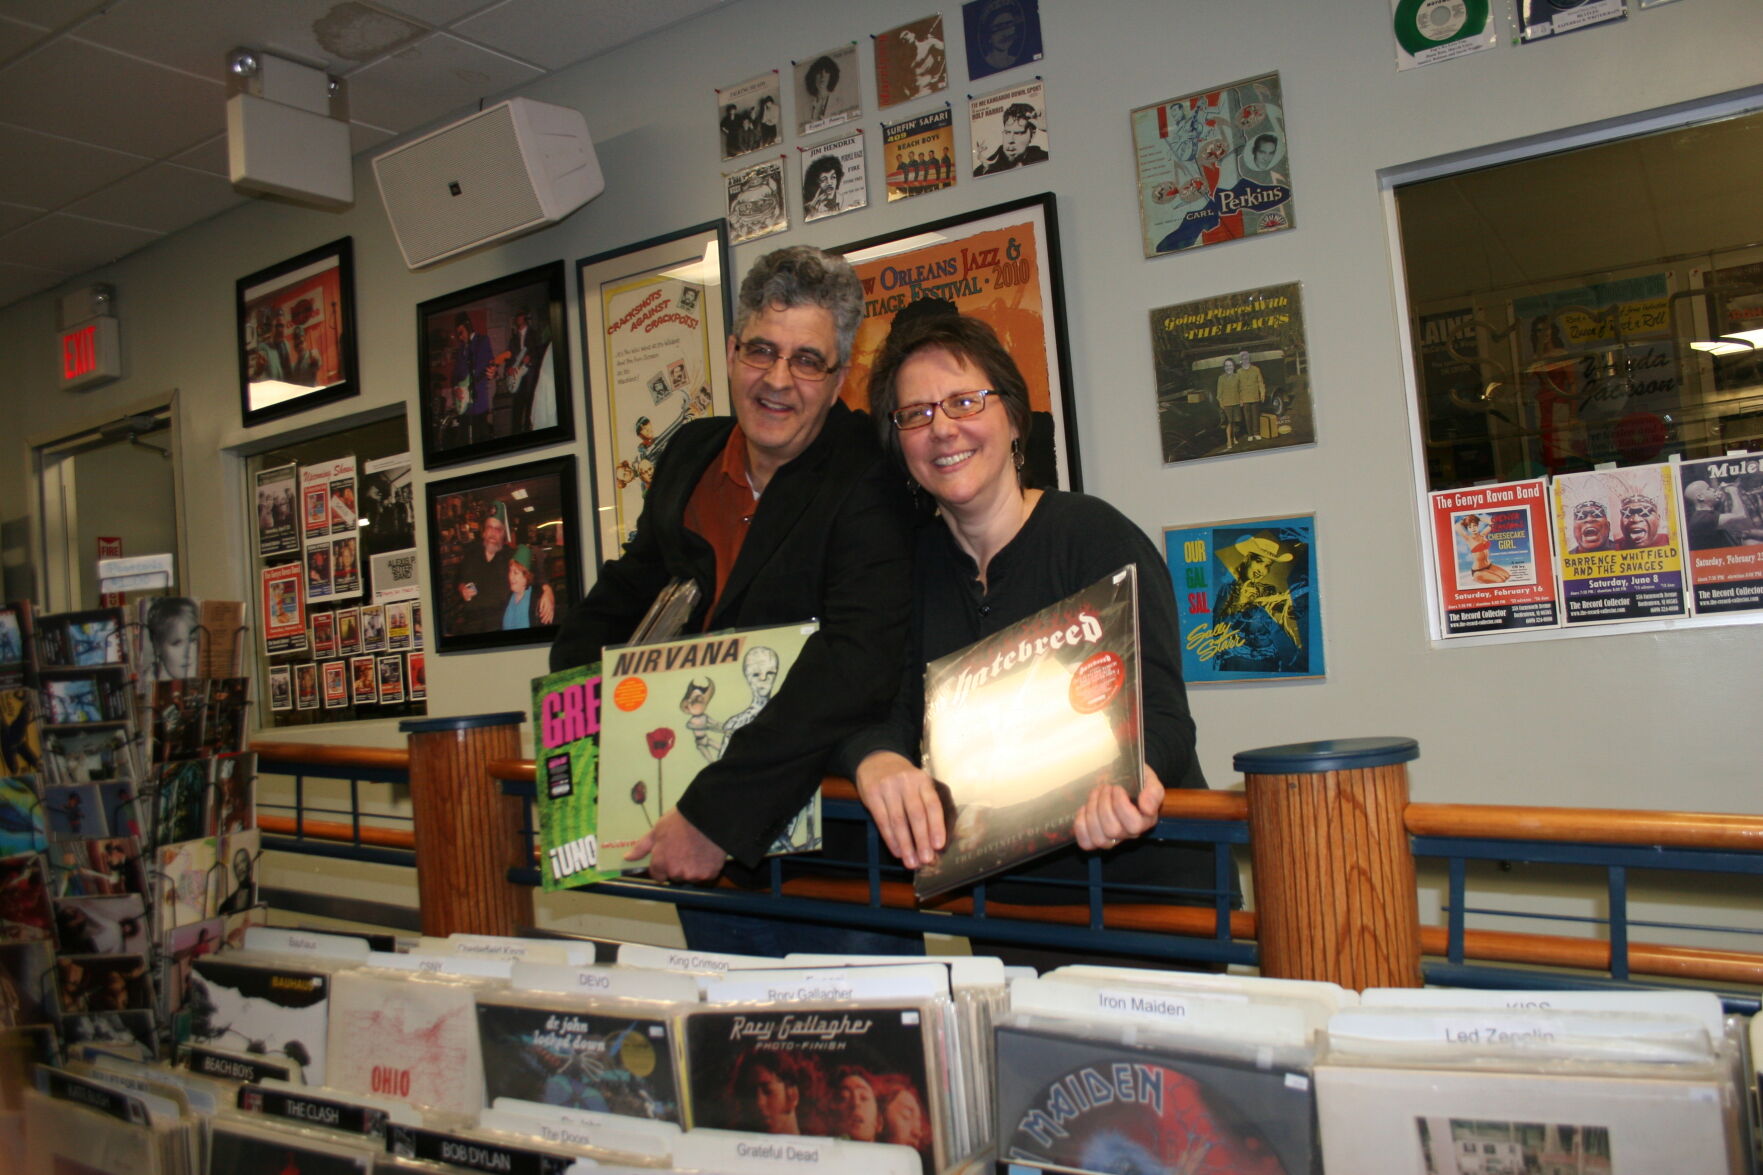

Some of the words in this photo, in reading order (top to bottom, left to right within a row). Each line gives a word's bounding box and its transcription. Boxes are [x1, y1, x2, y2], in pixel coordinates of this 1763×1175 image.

[886, 120, 917, 137] SURFIN'
[920, 112, 949, 127] SAFARI
[823, 138, 856, 152] HENDRIX
[897, 140, 920, 151] BEACH
[922, 134, 940, 145] BOYS
[1218, 186, 1283, 212] Perkins
[1186, 210, 1214, 221] CARL
[880, 256, 958, 291] ORLEANS
[960, 247, 1001, 281] JAZZ
[1006, 237, 1022, 261] &
[863, 293, 907, 319] ITAGE
[910, 276, 983, 300] FESTIVAL
[992, 258, 1030, 290] 2010
[607, 289, 662, 335] CRACKSHOTS
[630, 299, 672, 332] AGAINST
[1164, 313, 1205, 331] Going
[1207, 304, 1253, 320] Places
[644, 313, 699, 333] CRACKPOTS!
[1184, 325, 1222, 340] THE
[64, 325, 97, 380] EXIT
[1579, 377, 1675, 412] Jacson
[1436, 496, 1453, 509] The
[1455, 493, 1484, 508] Genya
[1486, 489, 1514, 503] Ravan
[1516, 484, 1540, 499] Band
[1487, 530, 1526, 541] CHEESECAKE
[1498, 540, 1517, 550] GIRL
[101, 546, 119, 556] FIRE
[1183, 540, 1207, 562] OUR
[1565, 554, 1617, 568] BARRENCE
[1621, 548, 1678, 561] WHITFIELD
[1695, 557, 1725, 568] Saturday,
[1726, 554, 1756, 564] February
[1186, 565, 1208, 588] GAL
[1573, 565, 1593, 576] AND
[1597, 564, 1616, 575] THE
[1620, 561, 1664, 573] SAVAGES
[1589, 578, 1628, 588] Saturday,
[1631, 576, 1650, 585] June
[1653, 575, 1659, 583] 8
[1188, 591, 1210, 614] SAL
[1454, 591, 1492, 600] Saturday,
[1494, 587, 1530, 596] February
[1533, 585, 1543, 593] 16
[1698, 590, 1711, 599] The
[1712, 588, 1735, 598] Record
[1570, 601, 1581, 610] The
[1582, 600, 1603, 608] Record
[1604, 597, 1630, 607] Collector
[1449, 613, 1460, 621] The
[1461, 611, 1481, 620] Record
[1482, 609, 1507, 618] Collector
[1186, 621, 1231, 650] Sally
[1199, 630, 1246, 662] Starr
[612, 638, 743, 677] NIRVANA
[541, 675, 602, 749] GRE
[669, 955, 690, 970] King
[691, 956, 729, 971] Crimson
[272, 976, 314, 992] BAUHAUS
[579, 974, 609, 989] DEVO
[768, 988, 795, 1002] Rory
[797, 987, 853, 1002] Gallagher
[1099, 993, 1127, 1011] Iron
[1131, 996, 1186, 1017] Maiden
[545, 1014, 560, 1031] dr
[560, 1016, 589, 1034] john
[730, 1016, 774, 1041] Rory
[777, 1015, 874, 1041] Gallagher
[573, 1034, 607, 1052] down
[754, 1040, 847, 1051] PHOTO-FINISH
[1445, 1028, 1479, 1043] Led
[1485, 1028, 1555, 1044] Zeppelin
[204, 1056, 230, 1077] BEACH
[231, 1060, 254, 1081] BOYS
[371, 1065, 411, 1097] OHIO
[287, 1100, 306, 1120] THE
[307, 1102, 339, 1125] CLASH
[1018, 1062, 1164, 1149] MAIDEN
[542, 1126, 559, 1141] The
[560, 1130, 590, 1145] Doors
[442, 1141, 466, 1162] BOB
[467, 1145, 511, 1170] DYLAN
[737, 1143, 785, 1161] Grateful
[787, 1146, 819, 1163] Dead
